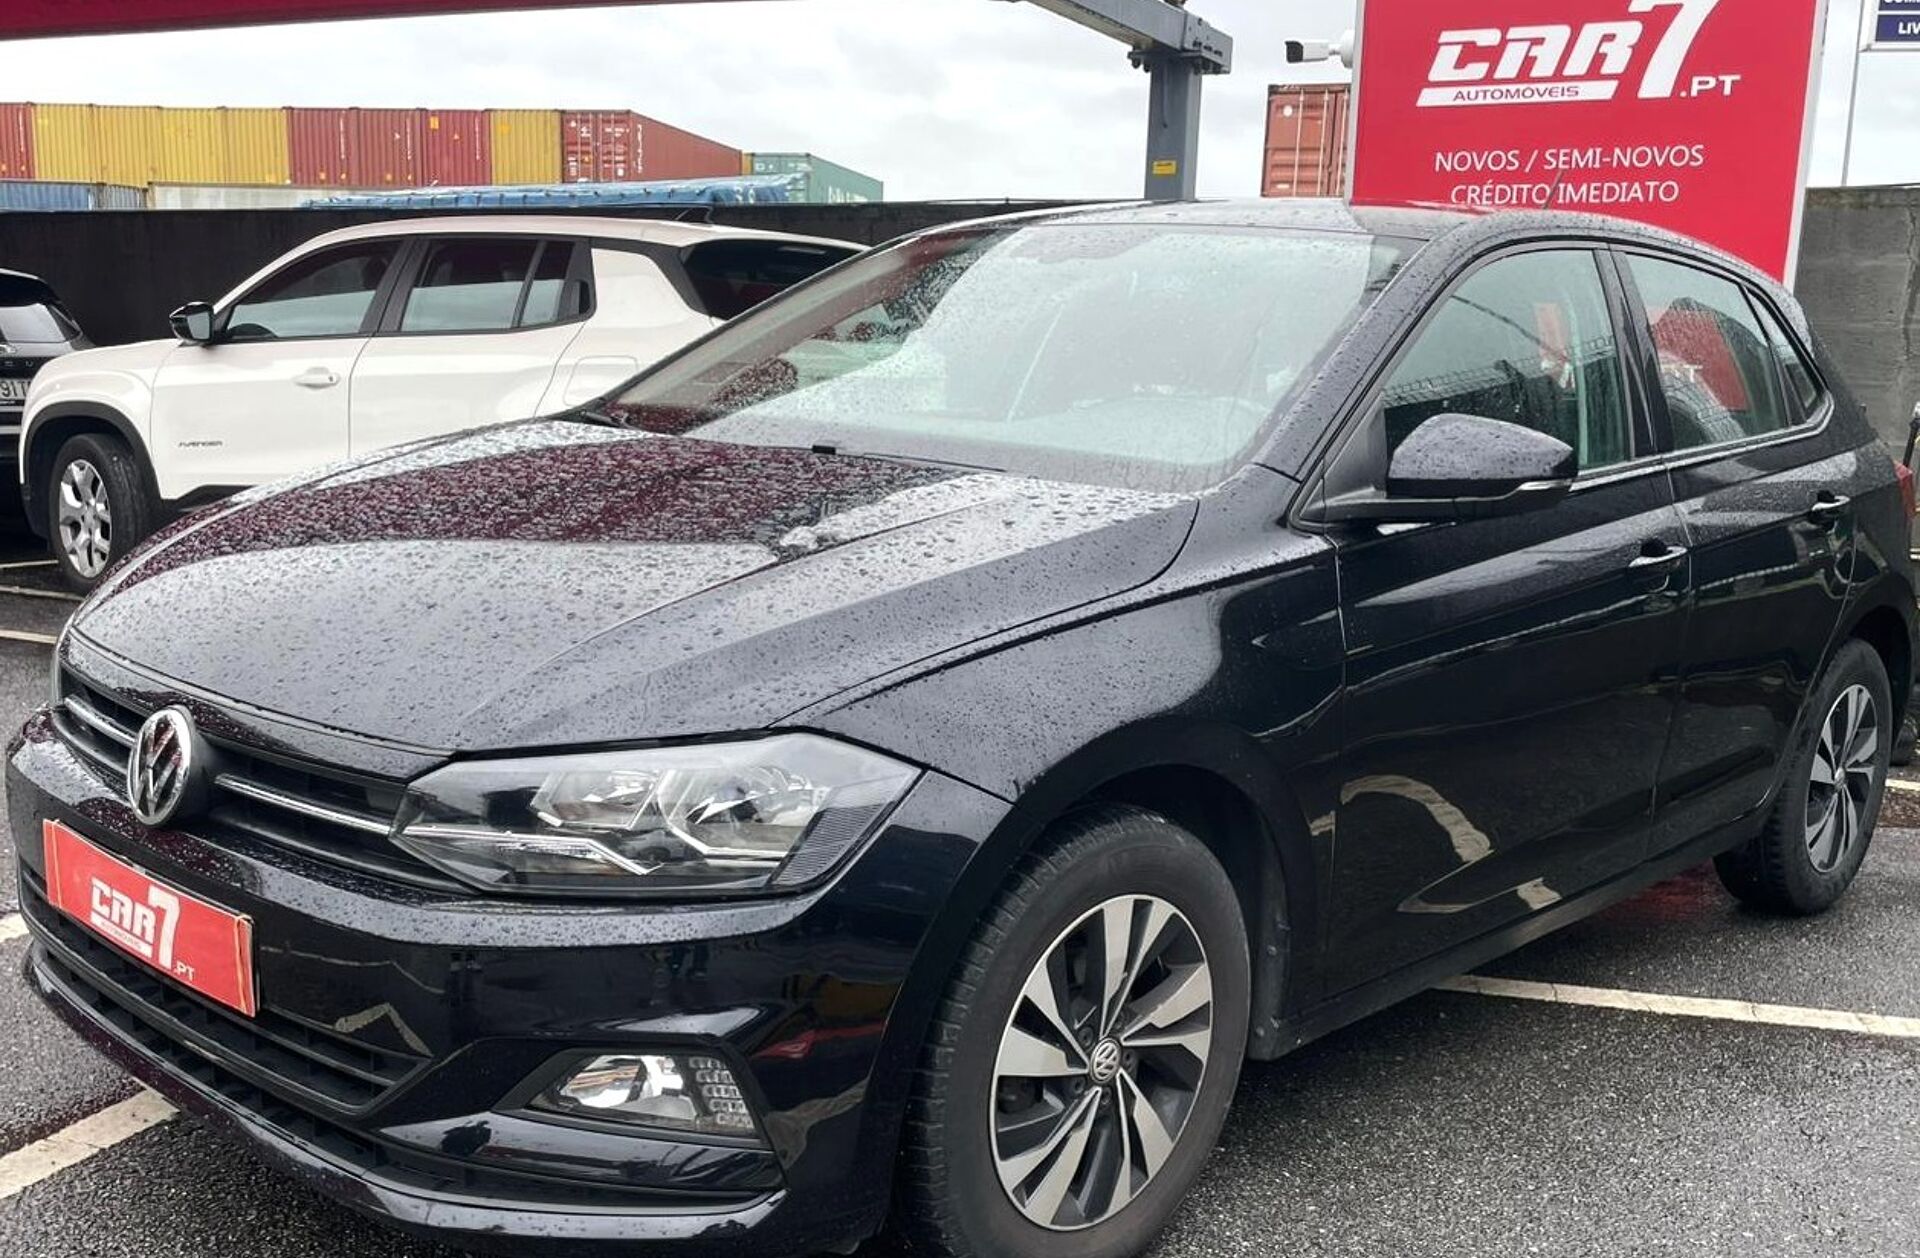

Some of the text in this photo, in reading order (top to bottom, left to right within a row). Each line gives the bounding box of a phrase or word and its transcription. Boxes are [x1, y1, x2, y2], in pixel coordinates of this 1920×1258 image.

[1434, 144, 1705, 173] NOVOS / SEMI-NOVOS
[1450, 179, 1680, 206] CRÉDITO IMEDIATO
